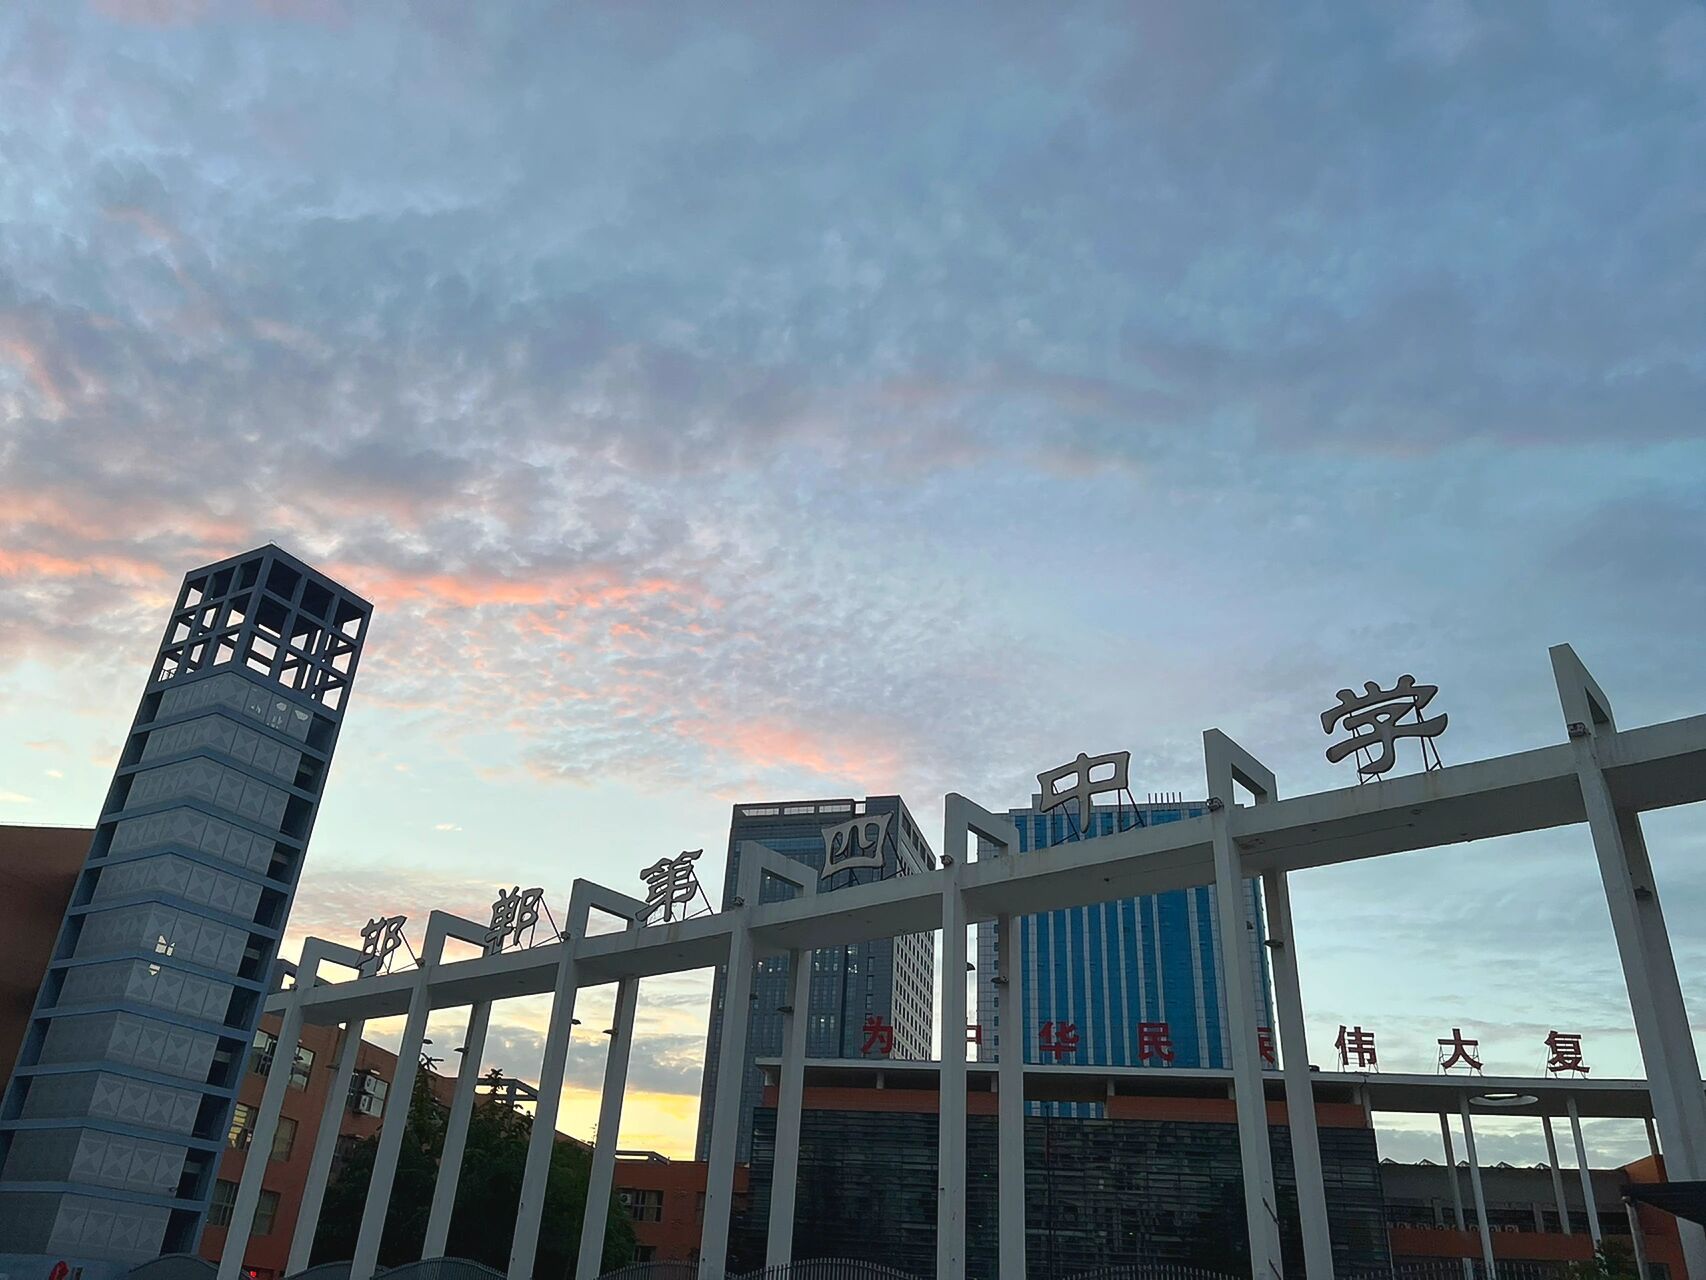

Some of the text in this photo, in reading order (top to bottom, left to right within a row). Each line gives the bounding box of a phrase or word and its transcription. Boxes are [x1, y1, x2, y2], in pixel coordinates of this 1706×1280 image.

[357, 674, 1448, 972] 邯郸第四中学
